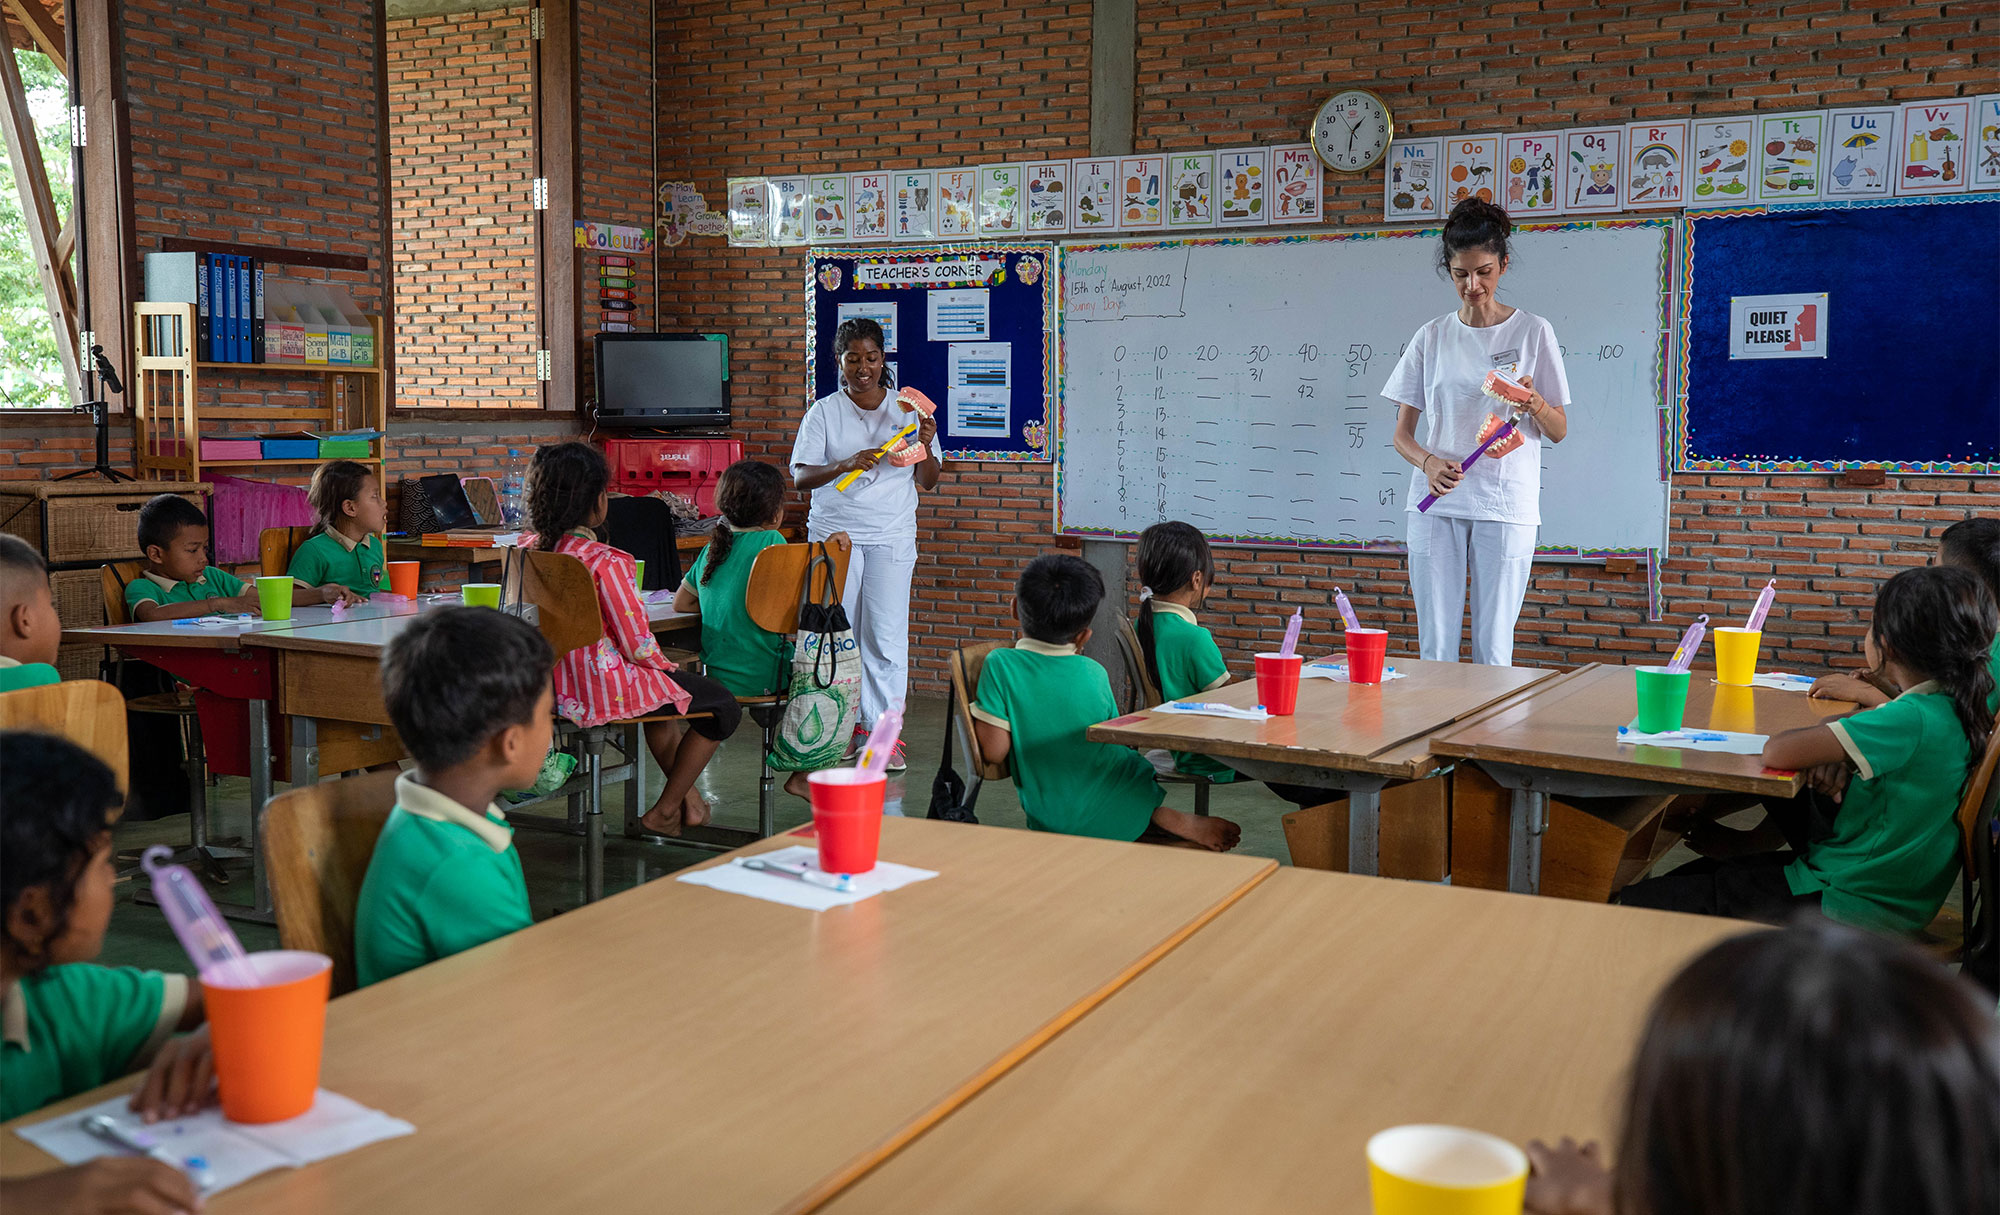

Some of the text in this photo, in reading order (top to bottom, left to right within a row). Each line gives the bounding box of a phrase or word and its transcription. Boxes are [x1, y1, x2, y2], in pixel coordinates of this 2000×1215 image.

[1336, 104, 1344, 112] 11
[1348, 98, 1358, 106] 12
[1326, 116, 1336, 124] 10
[1924, 108, 1950, 122] Vv
[1378, 125, 1384, 133] 3
[1782, 120, 1800, 134] Tt
[1851, 116, 1877, 129] Uu
[1322, 130, 1328, 138] 9
[1649, 129, 1667, 142] Rr
[1714, 126, 1732, 138] Ss
[1328, 144, 1334, 152] 8
[1462, 142, 1482, 154] Oo
[1523, 140, 1542, 156] Pp
[1582, 135, 1606, 152] Qq
[1284, 151, 1310, 164] Mm
[1337, 154, 1343, 162] 7
[1365, 151, 1371, 159] 5
[1404, 146, 1424, 158] Nn
[1184, 159, 1200, 170] Kk
[1351, 156, 1357, 164] 6
[1039, 168, 1056, 178] Hh
[1136, 162, 1148, 176] Jj
[863, 178, 878, 188] Dd
[907, 176, 919, 188] Ee
[952, 174, 963, 188] Ff
[993, 170, 1009, 184] Gg
[740, 185, 754, 196] Aa
[782, 182, 794, 192] Bb
[823, 180, 834, 190] Cc
[678, 194, 702, 202] Learn
[586, 224, 646, 250] Colours
[866, 264, 984, 280] TEACHER'S CORNER
[1068, 258, 1108, 280] Monday
[1071, 281, 1088, 296] 15th
[1095, 280, 1105, 294] of
[1069, 296, 1120, 316] Sunny Day
[1750, 311, 1788, 326] QUIET
[331, 335, 349, 346] Math
[1746, 330, 1791, 344] PLEASE
[1114, 346, 1126, 362] 0
[1154, 345, 1168, 362] 10
[1197, 345, 1219, 361] 20
[1246, 345, 1270, 364] 30
[1298, 343, 1318, 362] 40
[1345, 344, 1372, 363] 50
[1598, 345, 1624, 361] 100
[1156, 366, 1163, 380] 11
[1249, 368, 1263, 382] 31
[1349, 362, 1367, 378] 51
[1115, 385, 1314, 401] 2 12 42
[1117, 404, 1125, 419] 3
[1156, 407, 1166, 422] 13
[1117, 421, 1167, 440] 4 14
[1348, 426, 1365, 449] 55
[1117, 440, 1166, 461] 5 15
[1118, 457, 1166, 479] 6 16
[1118, 475, 1166, 498] 7 17
[1118, 488, 1396, 514] 8 18 67
[1119, 505, 1126, 520] 9
